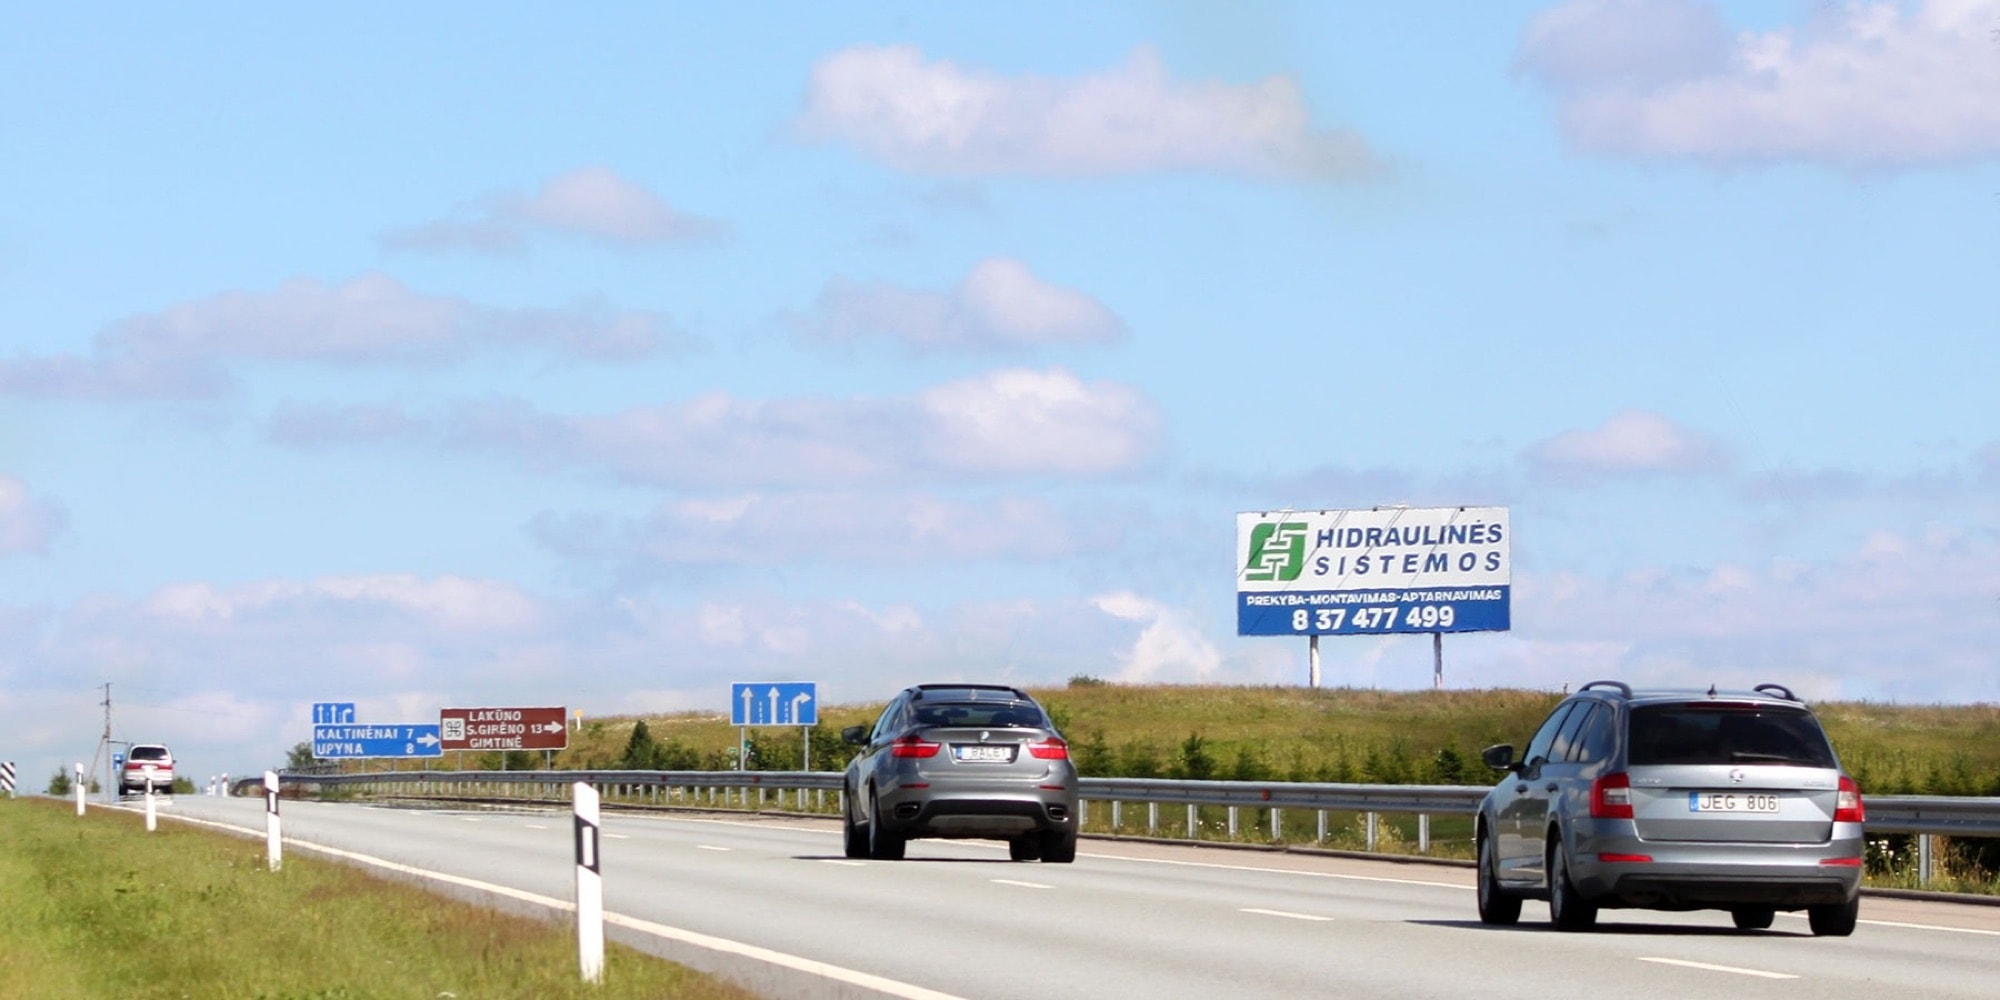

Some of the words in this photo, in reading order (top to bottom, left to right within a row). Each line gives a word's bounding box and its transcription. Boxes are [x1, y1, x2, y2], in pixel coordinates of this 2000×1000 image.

[1315, 519, 1503, 548] HIDRAULINĖS
[1313, 551, 1502, 576] SISTEMOS
[1292, 609, 1309, 631] 8
[1315, 608, 1347, 630] 37
[1351, 607, 1399, 629] 477
[1405, 605, 1454, 628] 499
[469, 709, 522, 722] LAKŪNO
[316, 725, 398, 740] KALTINĖNAI
[405, 728, 415, 740] 7
[530, 724, 543, 734] 13
[316, 742, 364, 755] UPYNA
[405, 742, 415, 754] 8
[469, 735, 523, 748] GIMTINĖ
[1700, 795, 1736, 810] JEG
[1746, 795, 1778, 811] 806
